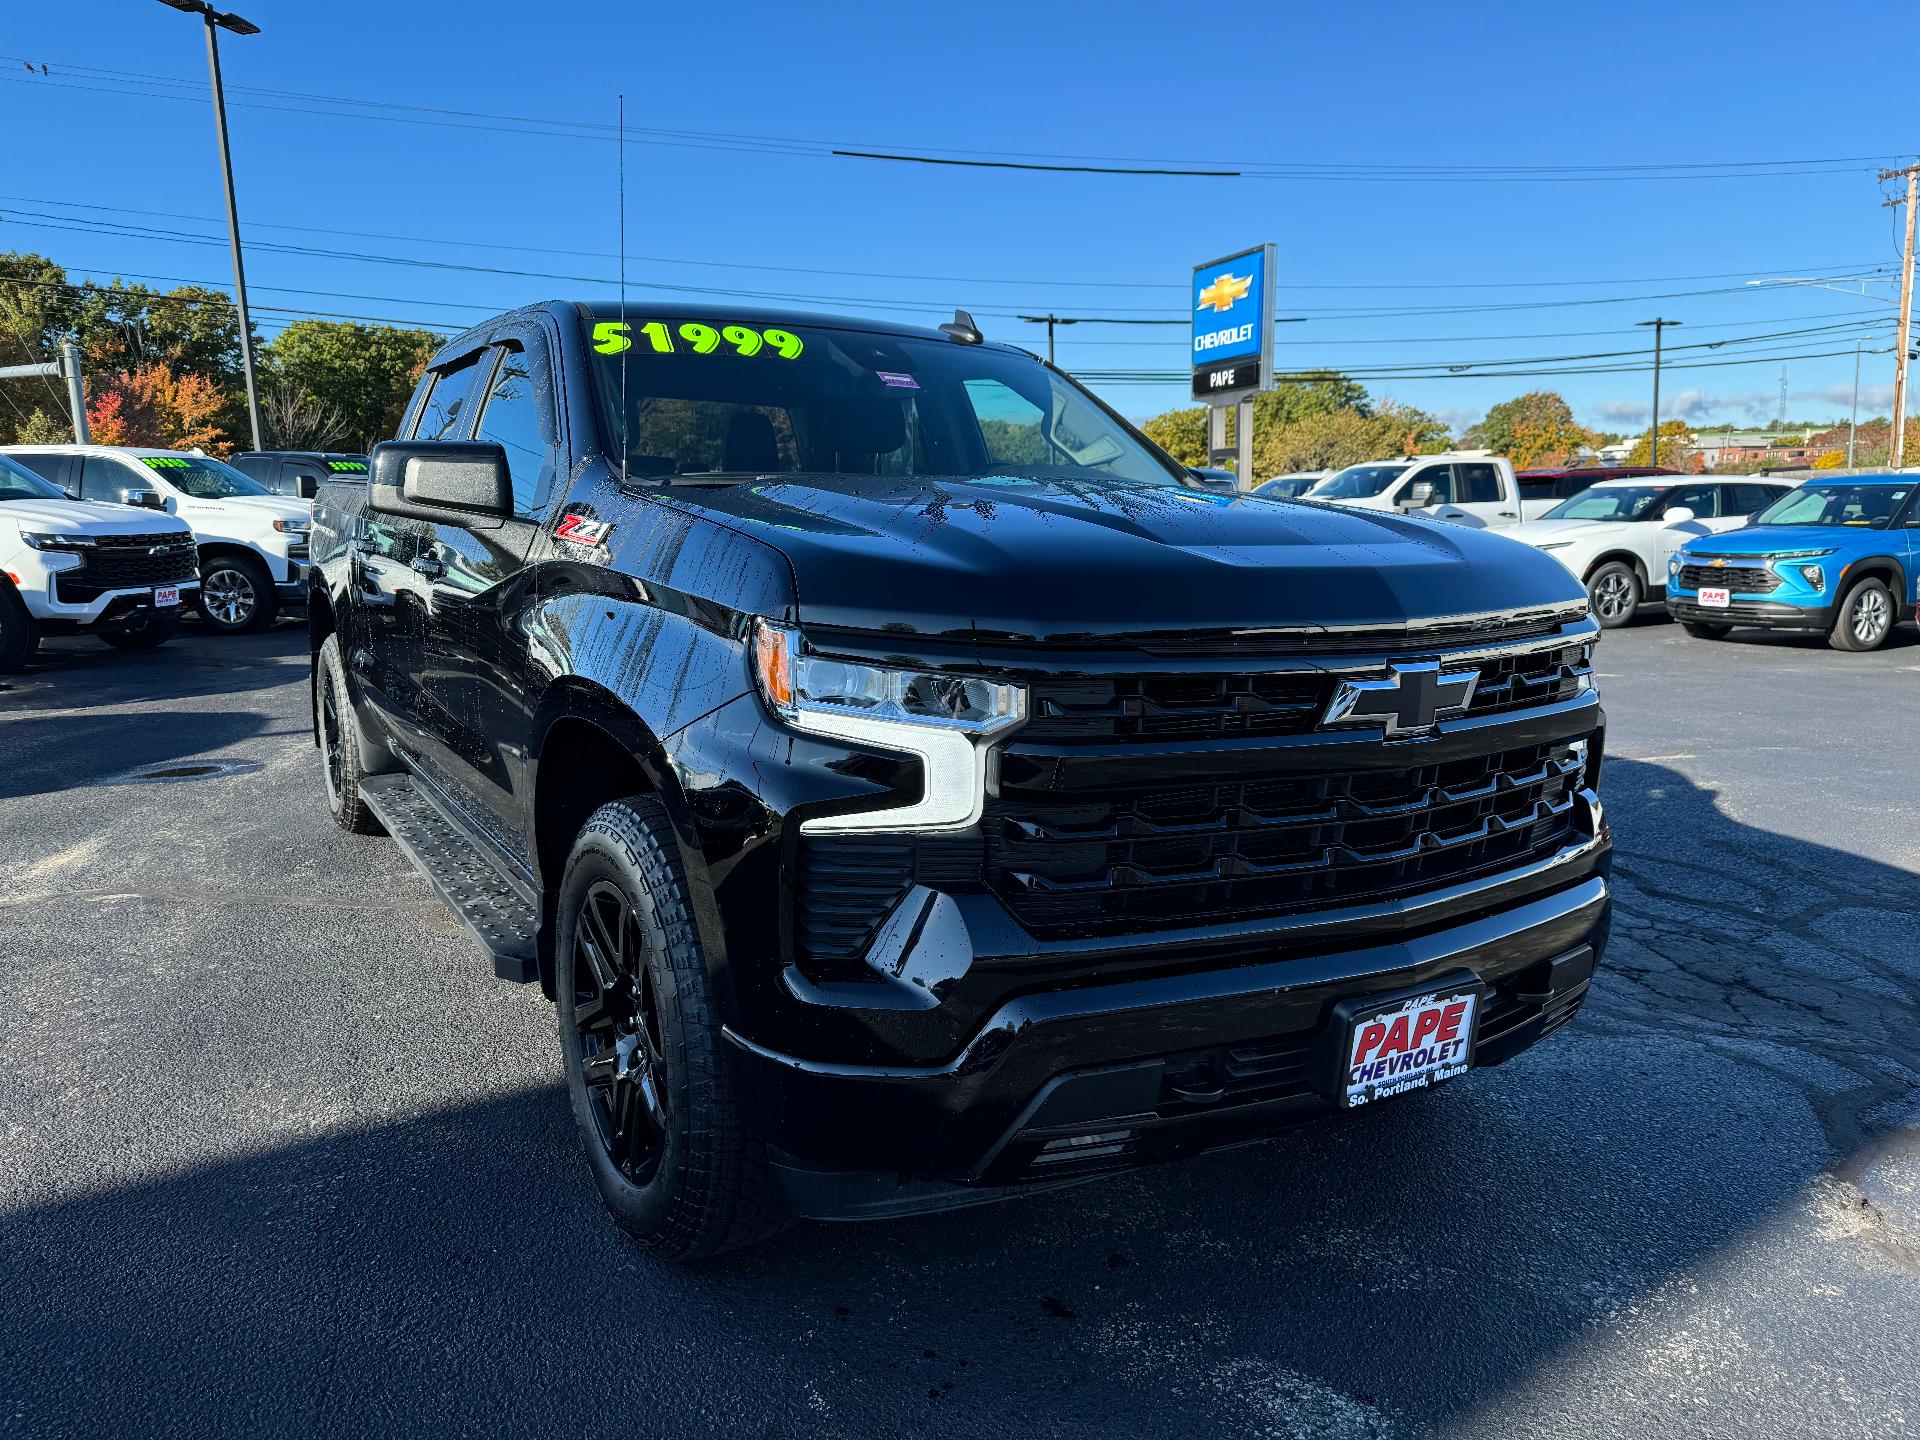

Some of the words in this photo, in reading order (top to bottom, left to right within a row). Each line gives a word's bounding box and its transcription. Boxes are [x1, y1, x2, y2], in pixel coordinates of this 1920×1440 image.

[593, 322, 804, 360] 51999
[1194, 323, 1254, 351] CHEVROLET
[1210, 369, 1235, 388] PAPE
[555, 513, 613, 547] Z71
[157, 590, 177, 599] PAPE
[1402, 994, 1437, 1011] PAPE
[1353, 1001, 1468, 1066] PAPE
[1348, 1038, 1465, 1086] CHEVROLET
[1348, 1094, 1369, 1108] So.
[1374, 1077, 1429, 1100] Portland,
[1434, 1063, 1468, 1082] Maine
